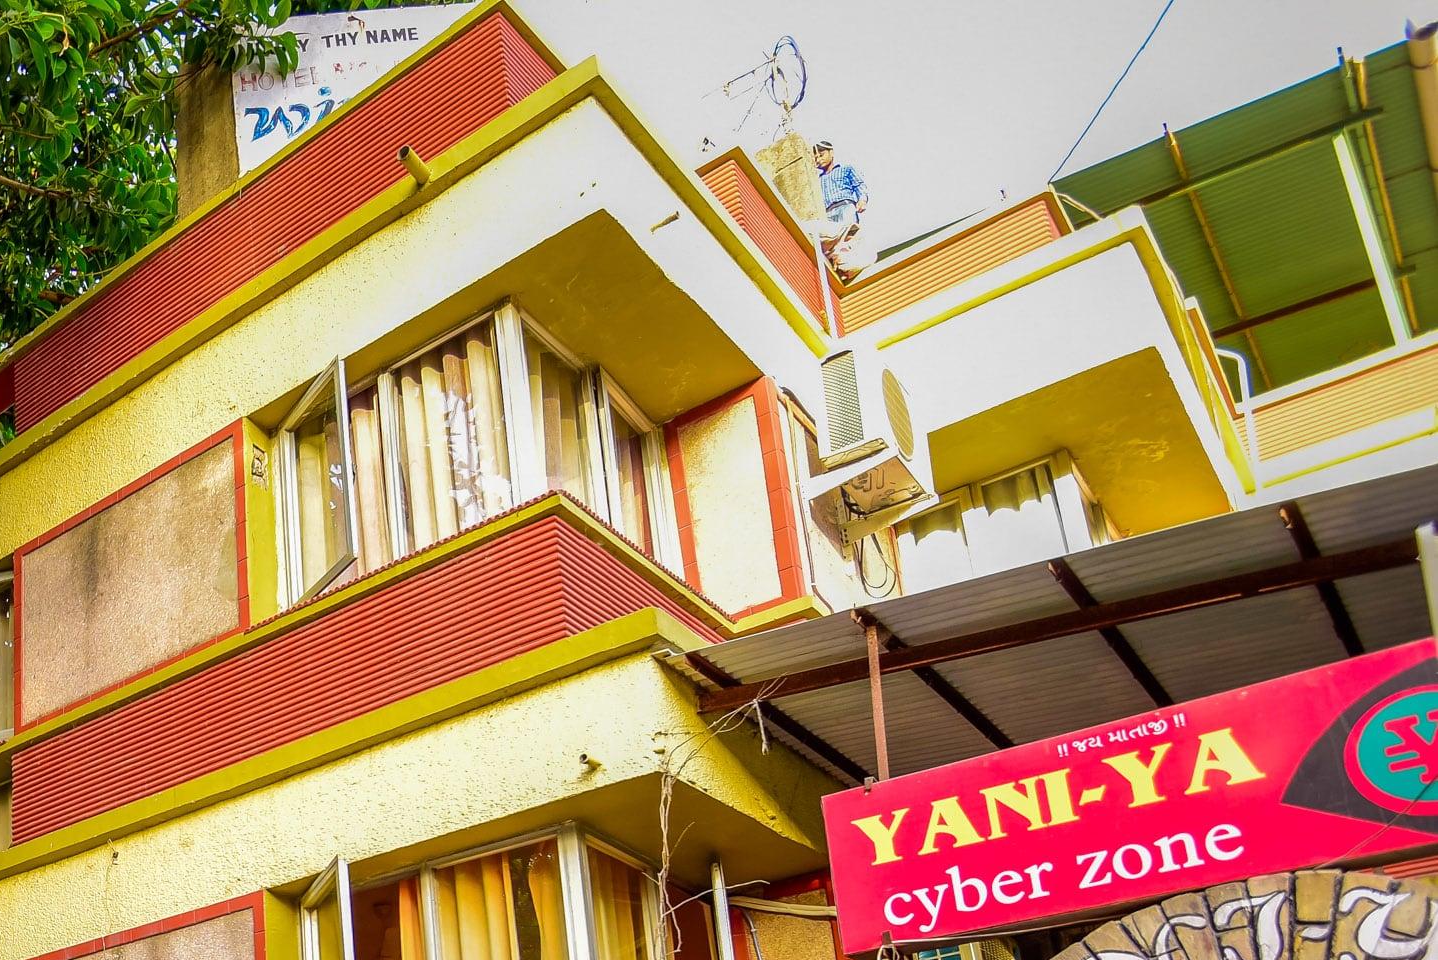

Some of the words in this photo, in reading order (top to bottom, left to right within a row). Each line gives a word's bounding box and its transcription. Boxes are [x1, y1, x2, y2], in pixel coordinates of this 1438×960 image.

[321, 31, 359, 49] THY
[365, 27, 419, 45] NAME
[882, 862, 1055, 934] cyber
[1075, 822, 1245, 891] zone
